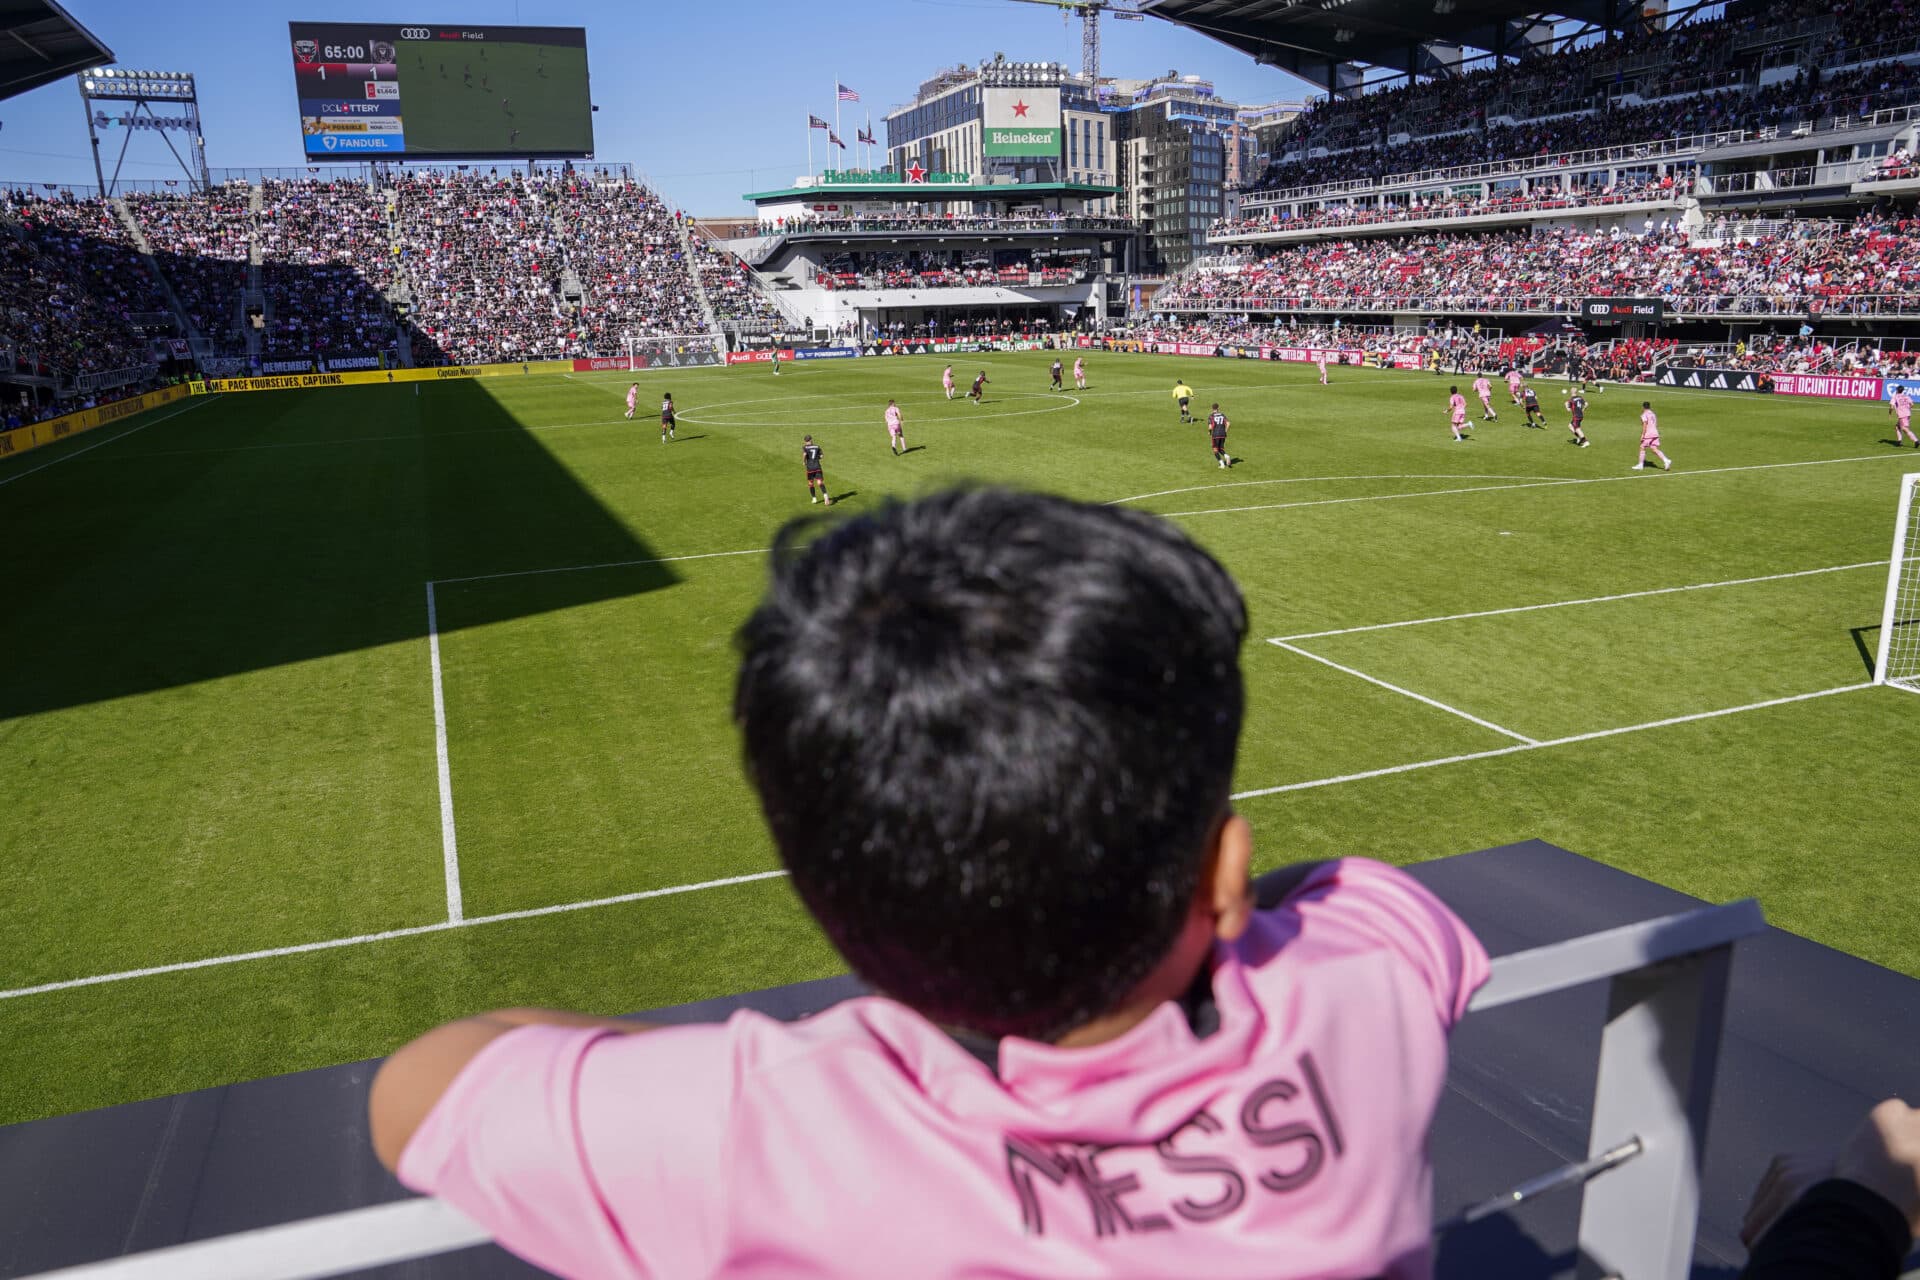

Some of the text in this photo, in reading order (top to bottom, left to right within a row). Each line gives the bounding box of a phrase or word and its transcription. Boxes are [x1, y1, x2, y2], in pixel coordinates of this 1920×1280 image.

[462, 31, 484, 39] Field
[324, 45, 364, 59] 65:00
[317, 65, 326, 80] 1
[369, 66, 378, 80] 1
[340, 138, 388, 148] FANDUEL
[992, 131, 1053, 144] Heineken
[823, 169, 901, 184] Heineken
[1612, 305, 1655, 314] Audi Field
[731, 353, 750, 361] Audi
[437, 367, 482, 378] Captain Morgan
[192, 382, 204, 394] THE
[228, 380, 249, 391] PACE
[303, 374, 345, 386] CAPTAINS.
[1798, 376, 1877, 398] DCUNITED.COM
[810, 449, 816, 460] 7
[1004, 1050, 1346, 1238] MESSI
